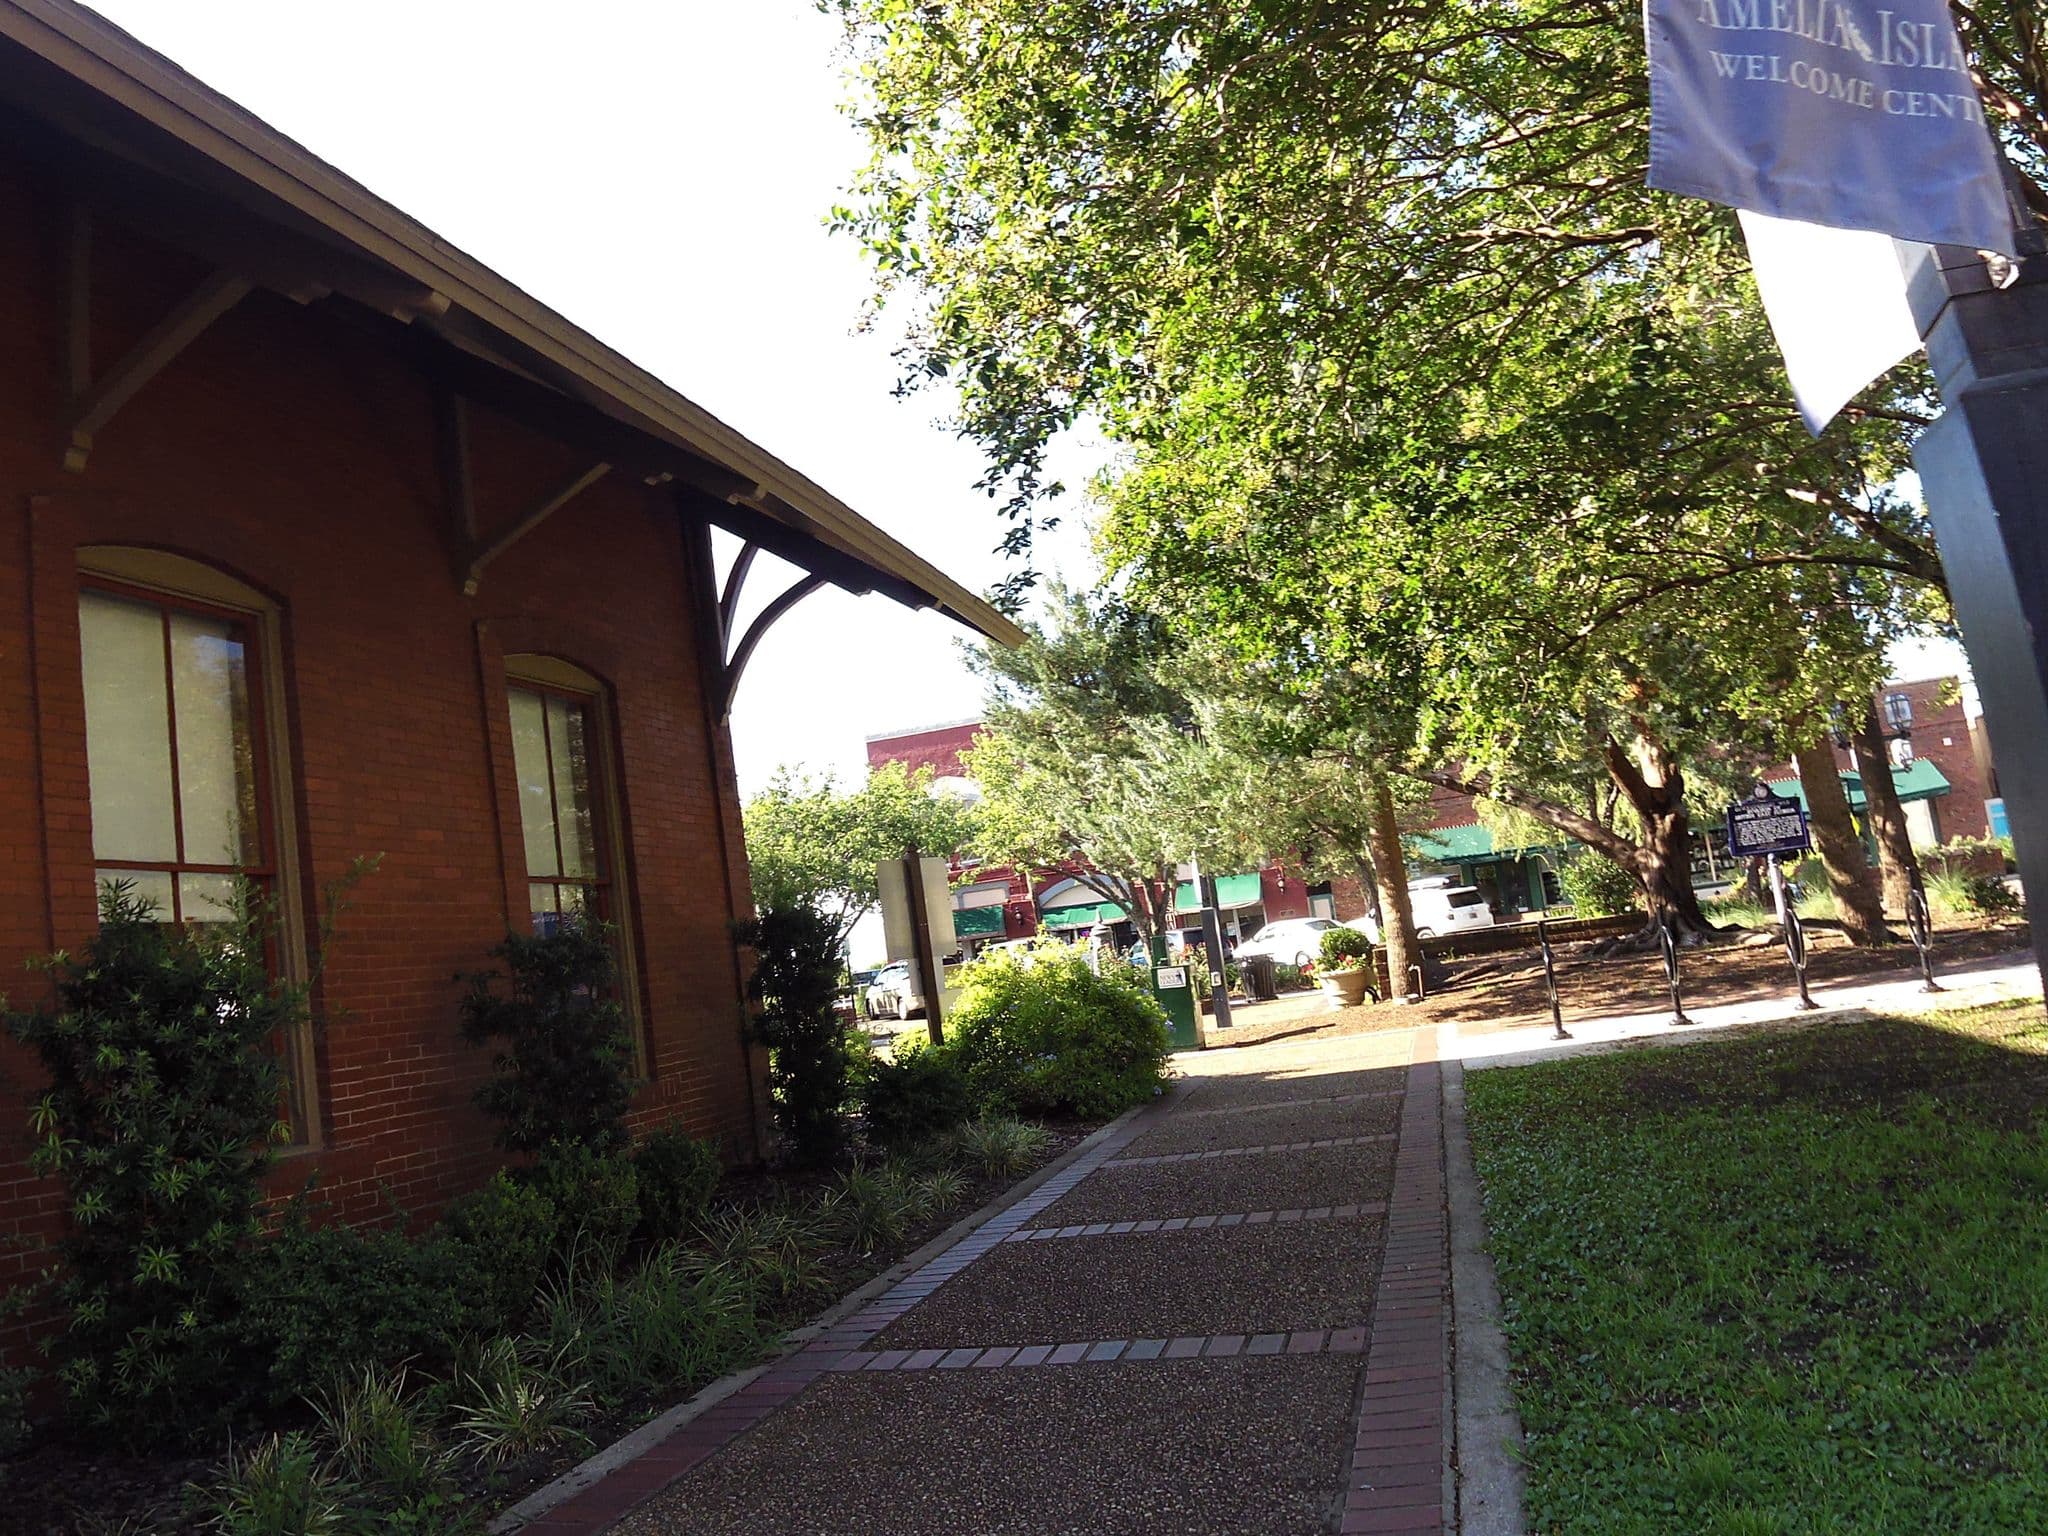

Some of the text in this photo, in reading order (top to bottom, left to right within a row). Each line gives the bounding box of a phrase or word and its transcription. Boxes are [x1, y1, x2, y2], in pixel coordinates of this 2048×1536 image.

[1695, 0, 1854, 51] AMELIA
[1709, 49, 1986, 127] WELCOME CENT
